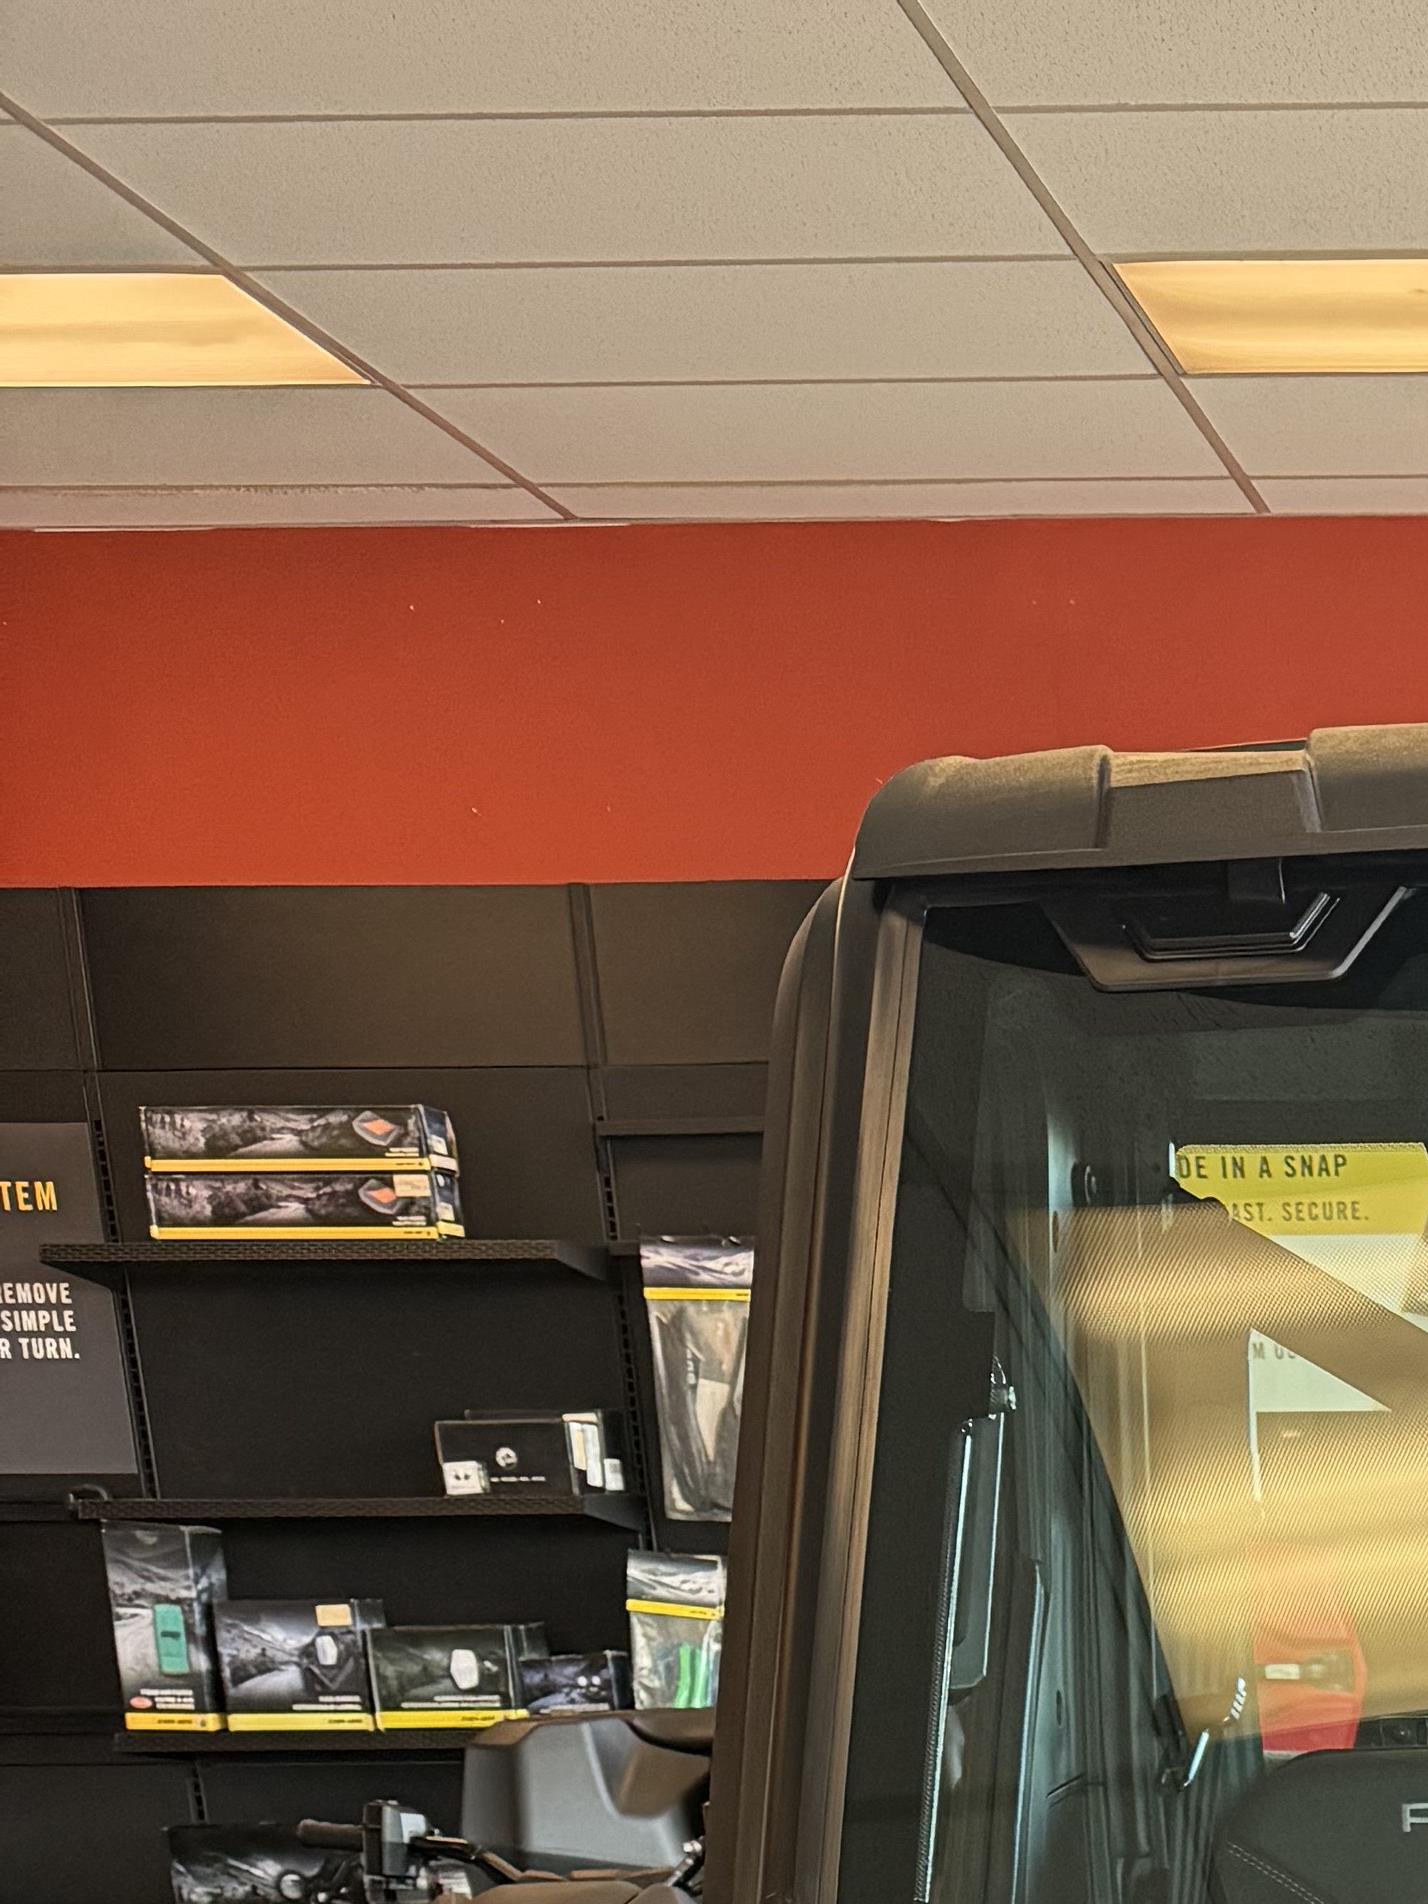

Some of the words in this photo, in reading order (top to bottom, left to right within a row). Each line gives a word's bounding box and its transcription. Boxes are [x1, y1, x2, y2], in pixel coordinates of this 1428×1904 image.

[1221, 1156, 1246, 1179] IN
[1258, 1155, 1272, 1178] A
[1284, 1154, 1348, 1178] SNAP
[0, 1181, 58, 1212] TEM
[1282, 1201, 1369, 1222] SECURE.
[0, 1282, 72, 1304] EMOVE
[1, 1310, 77, 1332] SIMPLE
[18, 1338, 80, 1360] TURN.
